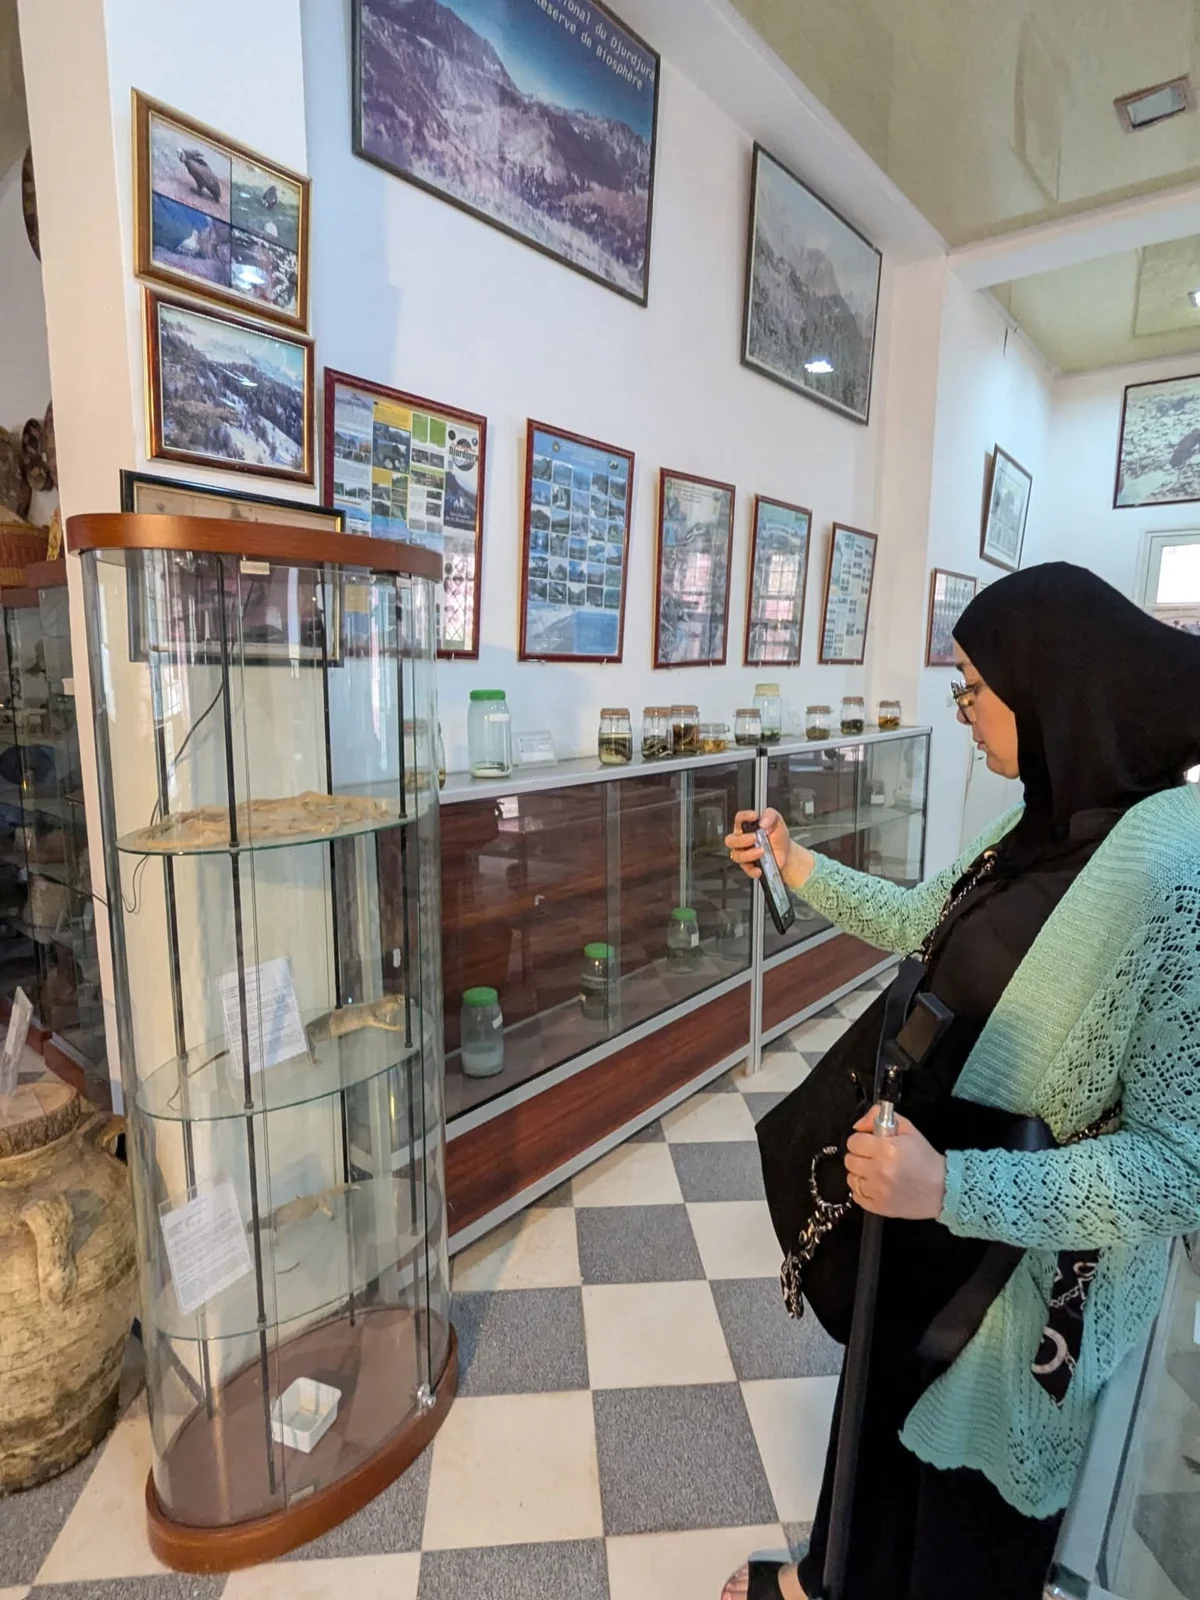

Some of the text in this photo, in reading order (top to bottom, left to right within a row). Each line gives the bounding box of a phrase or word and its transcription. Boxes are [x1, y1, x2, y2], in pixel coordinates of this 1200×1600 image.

[581, 32, 592, 49] de
[596, 45, 643, 91] Biosphère
[595, 23, 607, 40] du
[610, 36, 655, 82] Djurdjura
